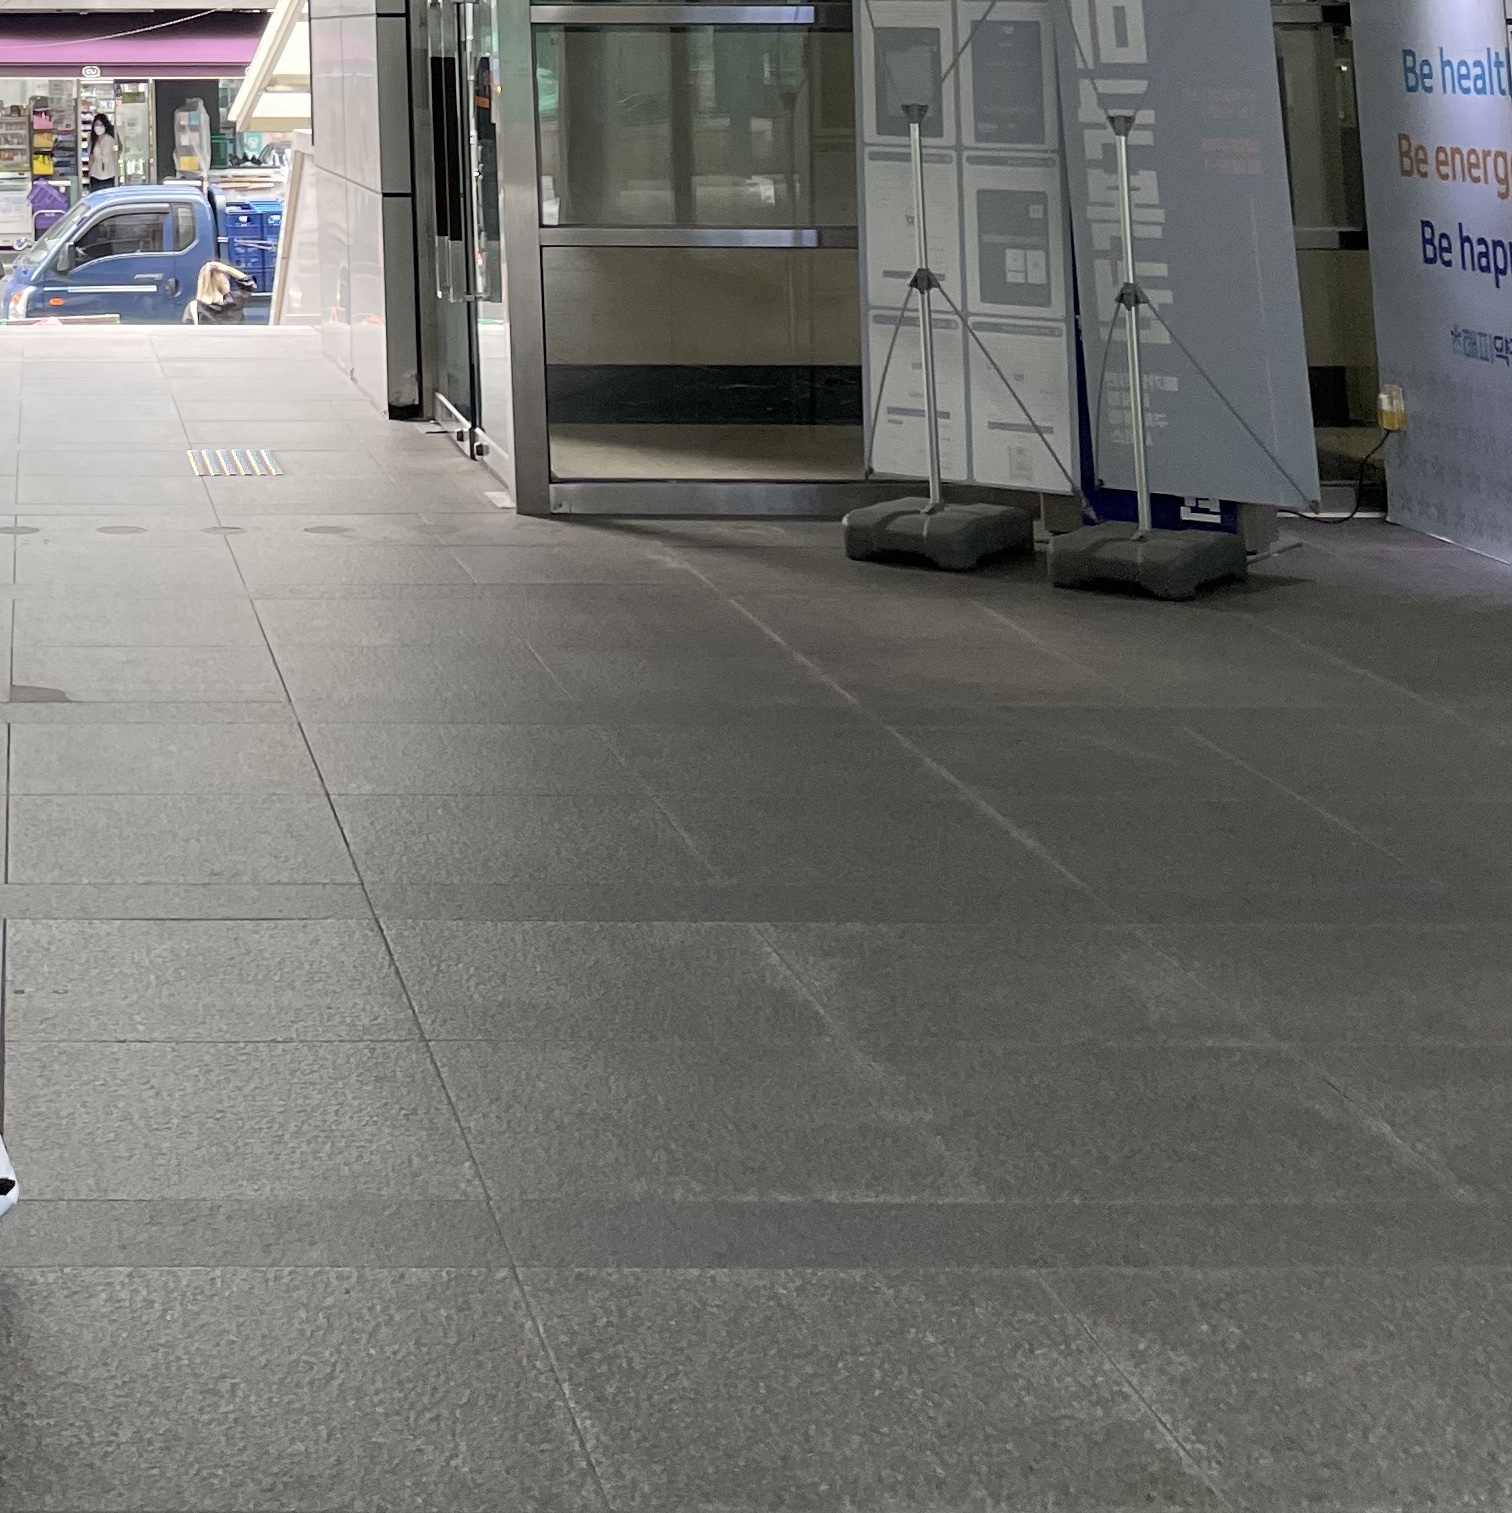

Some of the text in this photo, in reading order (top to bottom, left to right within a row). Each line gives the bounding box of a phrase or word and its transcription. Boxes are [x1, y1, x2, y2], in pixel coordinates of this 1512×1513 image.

[1402, 47, 1512, 97] Be healt
[1398, 133, 1512, 201] Be energ
[1421, 219, 1512, 289] Be hap
